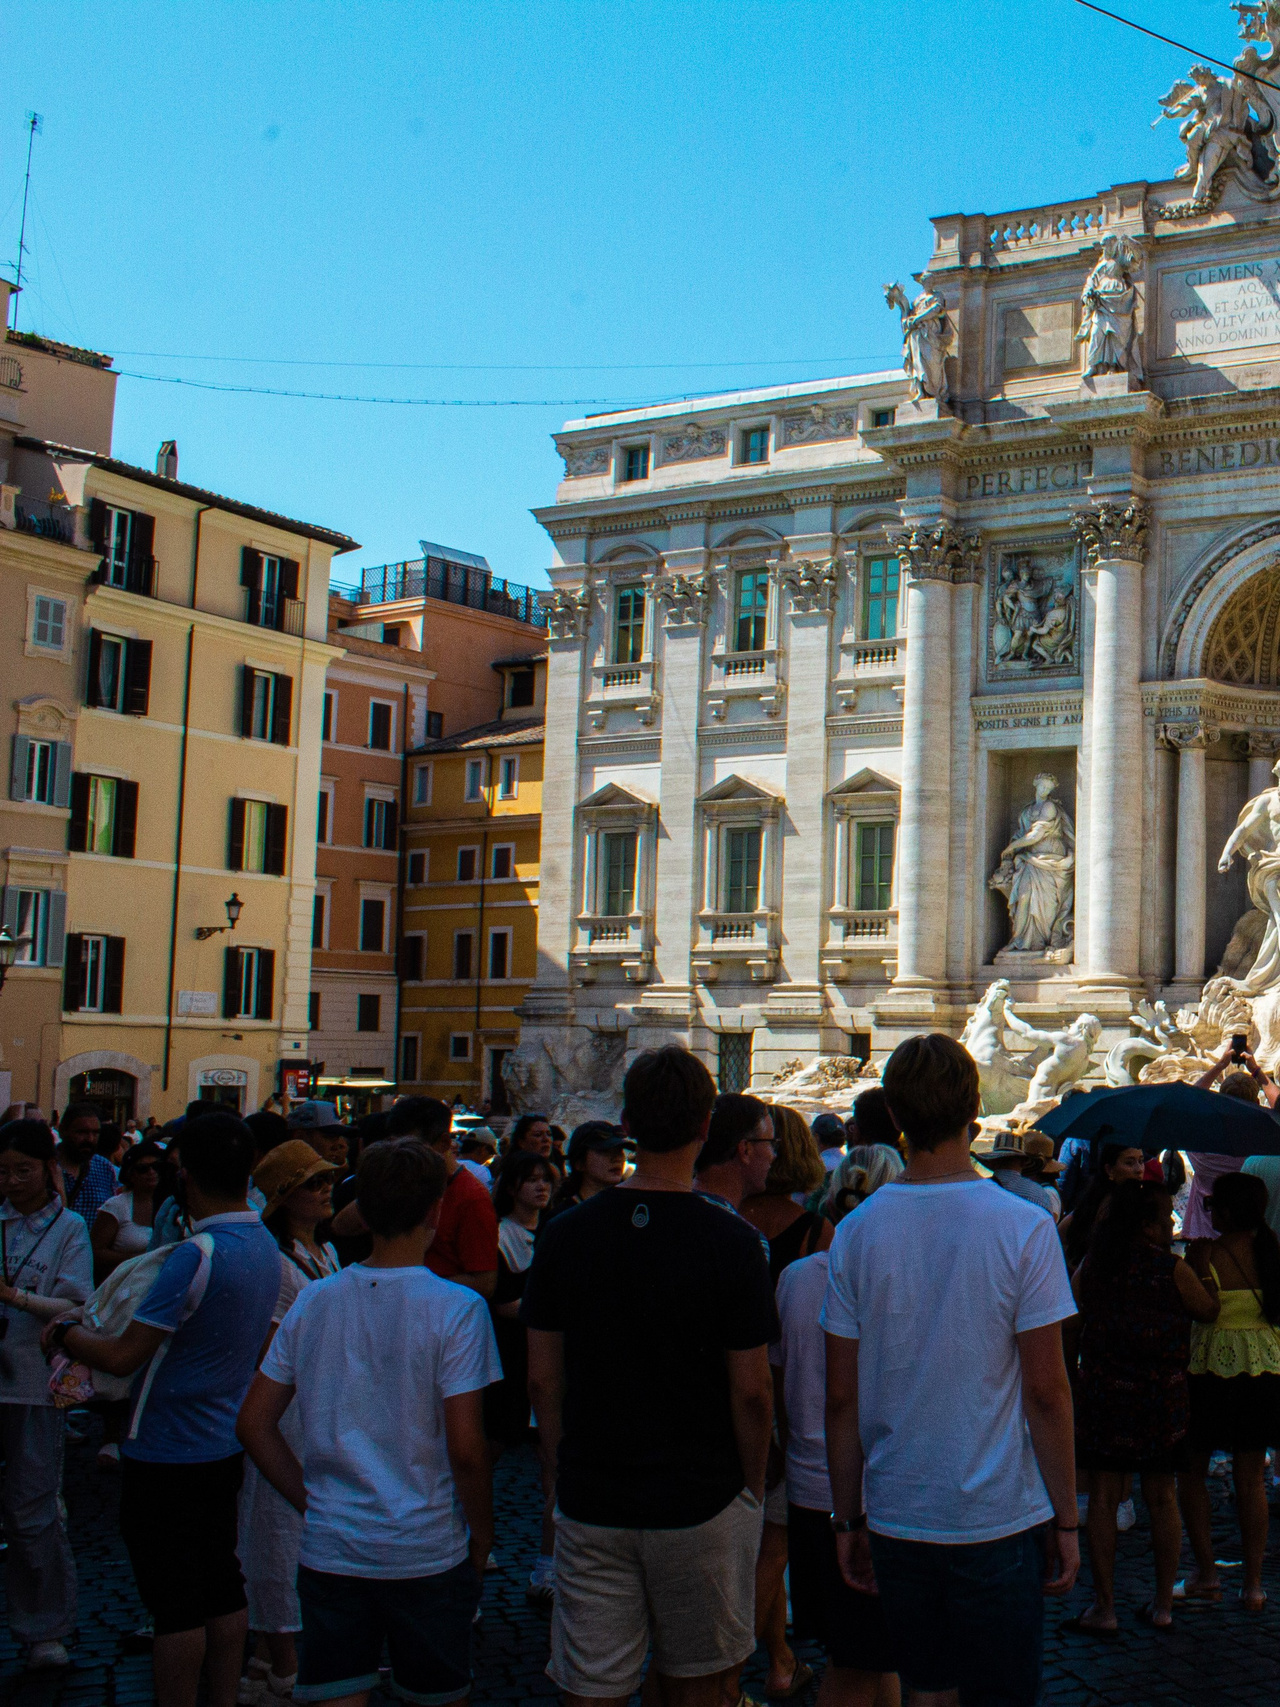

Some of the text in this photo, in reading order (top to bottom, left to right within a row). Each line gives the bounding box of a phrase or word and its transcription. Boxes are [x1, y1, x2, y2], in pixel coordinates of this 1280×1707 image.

[1185, 262, 1263, 287] CLEMENS
[1170, 305, 1209, 319] COPIA
[1214, 301, 1229, 313] ET
[1203, 314, 1246, 330] CVLTV
[1177, 334, 1214, 348] ANNO
[1219, 327, 1268, 343] DOMINI
[966, 460, 1093, 499] PERFECIT
[976, 718, 1009, 731] POSITIS
[1012, 717, 1041, 728] SIGNIS
[1046, 715, 1057, 725] ET
